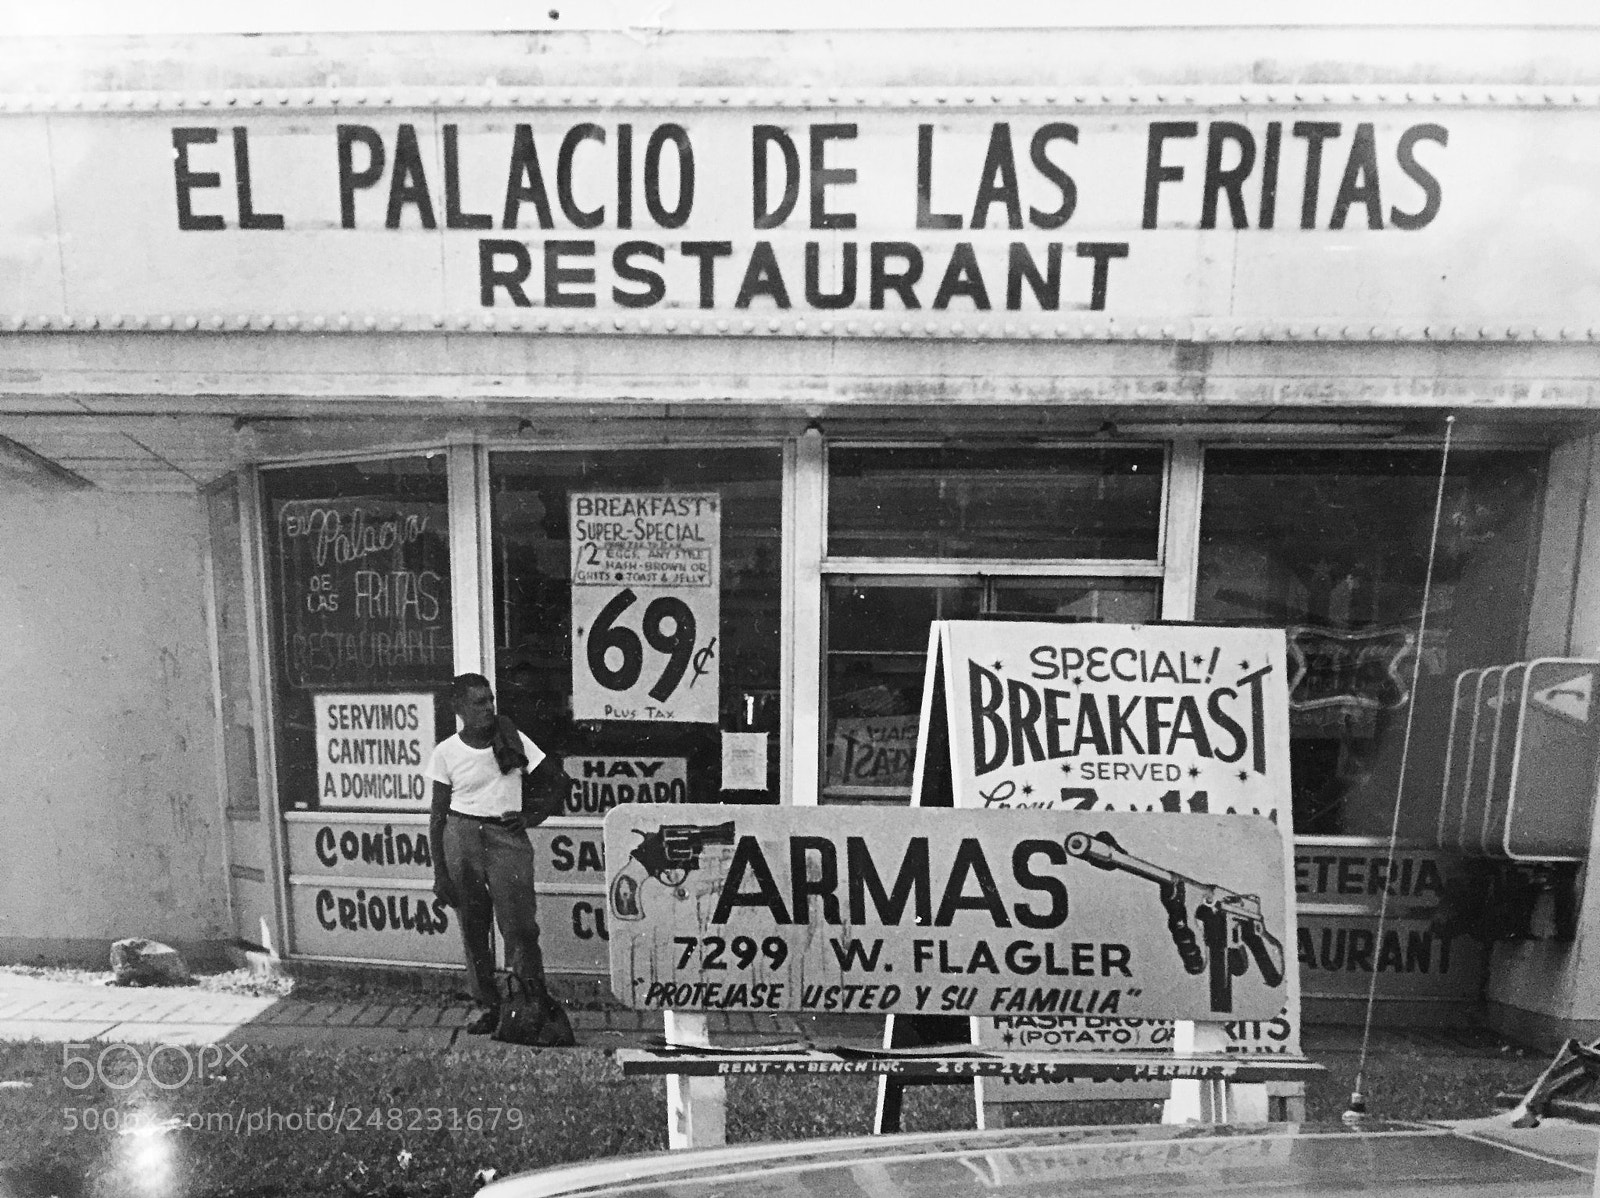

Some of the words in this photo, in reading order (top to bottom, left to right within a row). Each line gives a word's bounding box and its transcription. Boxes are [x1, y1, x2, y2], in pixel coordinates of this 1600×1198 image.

[171, 127, 284, 230] EL
[336, 123, 696, 230] PALACIO
[752, 124, 857, 231] DE
[917, 123, 1079, 231] LAS
[1141, 121, 1449, 231] FRITAS
[479, 239, 1129, 312] RESTAURANT
[576, 497, 706, 518] BREAKFAST
[576, 518, 705, 542] SUPER-SPECIAL
[584, 541, 601, 566] 2
[354, 570, 441, 621] FRITAS
[1029, 645, 1221, 684] SPECIAL!
[327, 704, 419, 730] SERVIMOS
[968, 658, 1273, 776] BREAKFAST
[327, 739, 421, 766] CANTINAS
[583, 760, 666, 778] HAY
[1080, 762, 1182, 782] SERVED
[324, 772, 337, 798] A
[341, 773, 425, 800] DOMICILIO
[712, 835, 1069, 929] ARMAS
[673, 936, 789, 972] 7299
[830, 937, 893, 973] W.
[913, 940, 1133, 978] FLAGLER
[803, 984, 902, 1011] USTED
[915, 985, 931, 1011] Y
[941, 985, 978, 1011] SU
[718, 1062, 868, 1073] RENT-A-BENCH
[871, 1061, 905, 1073] INC.
